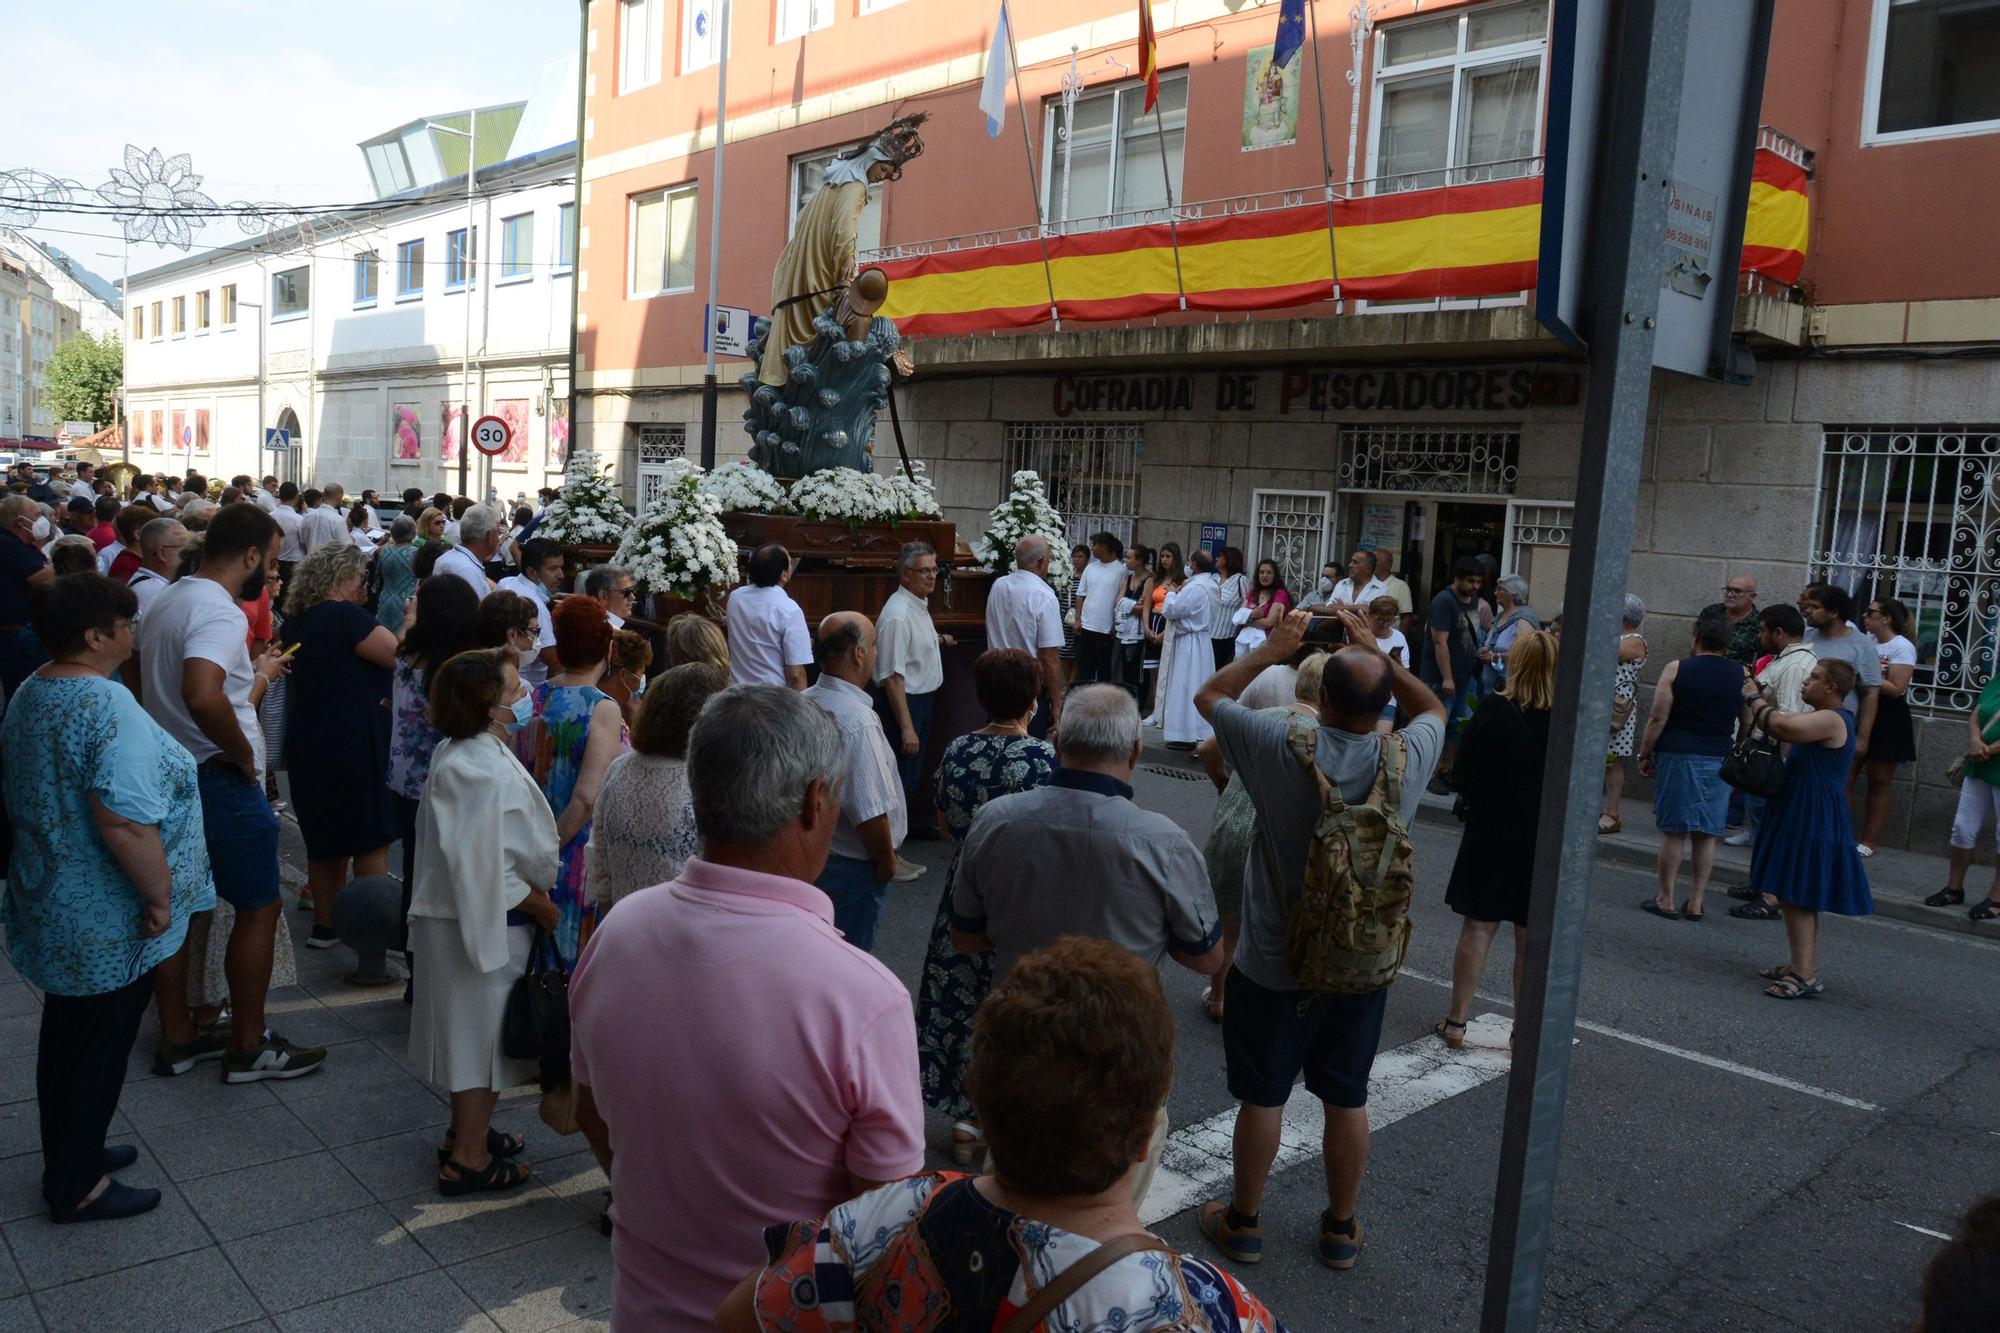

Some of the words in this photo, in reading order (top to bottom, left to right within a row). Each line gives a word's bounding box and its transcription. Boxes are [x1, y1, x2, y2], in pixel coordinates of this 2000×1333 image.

[1674, 199, 1712, 221] SINAIS
[1216, 375, 1255, 411] DE
[1280, 366, 1532, 414] PESCADORES
[480, 428, 503, 443] 30
